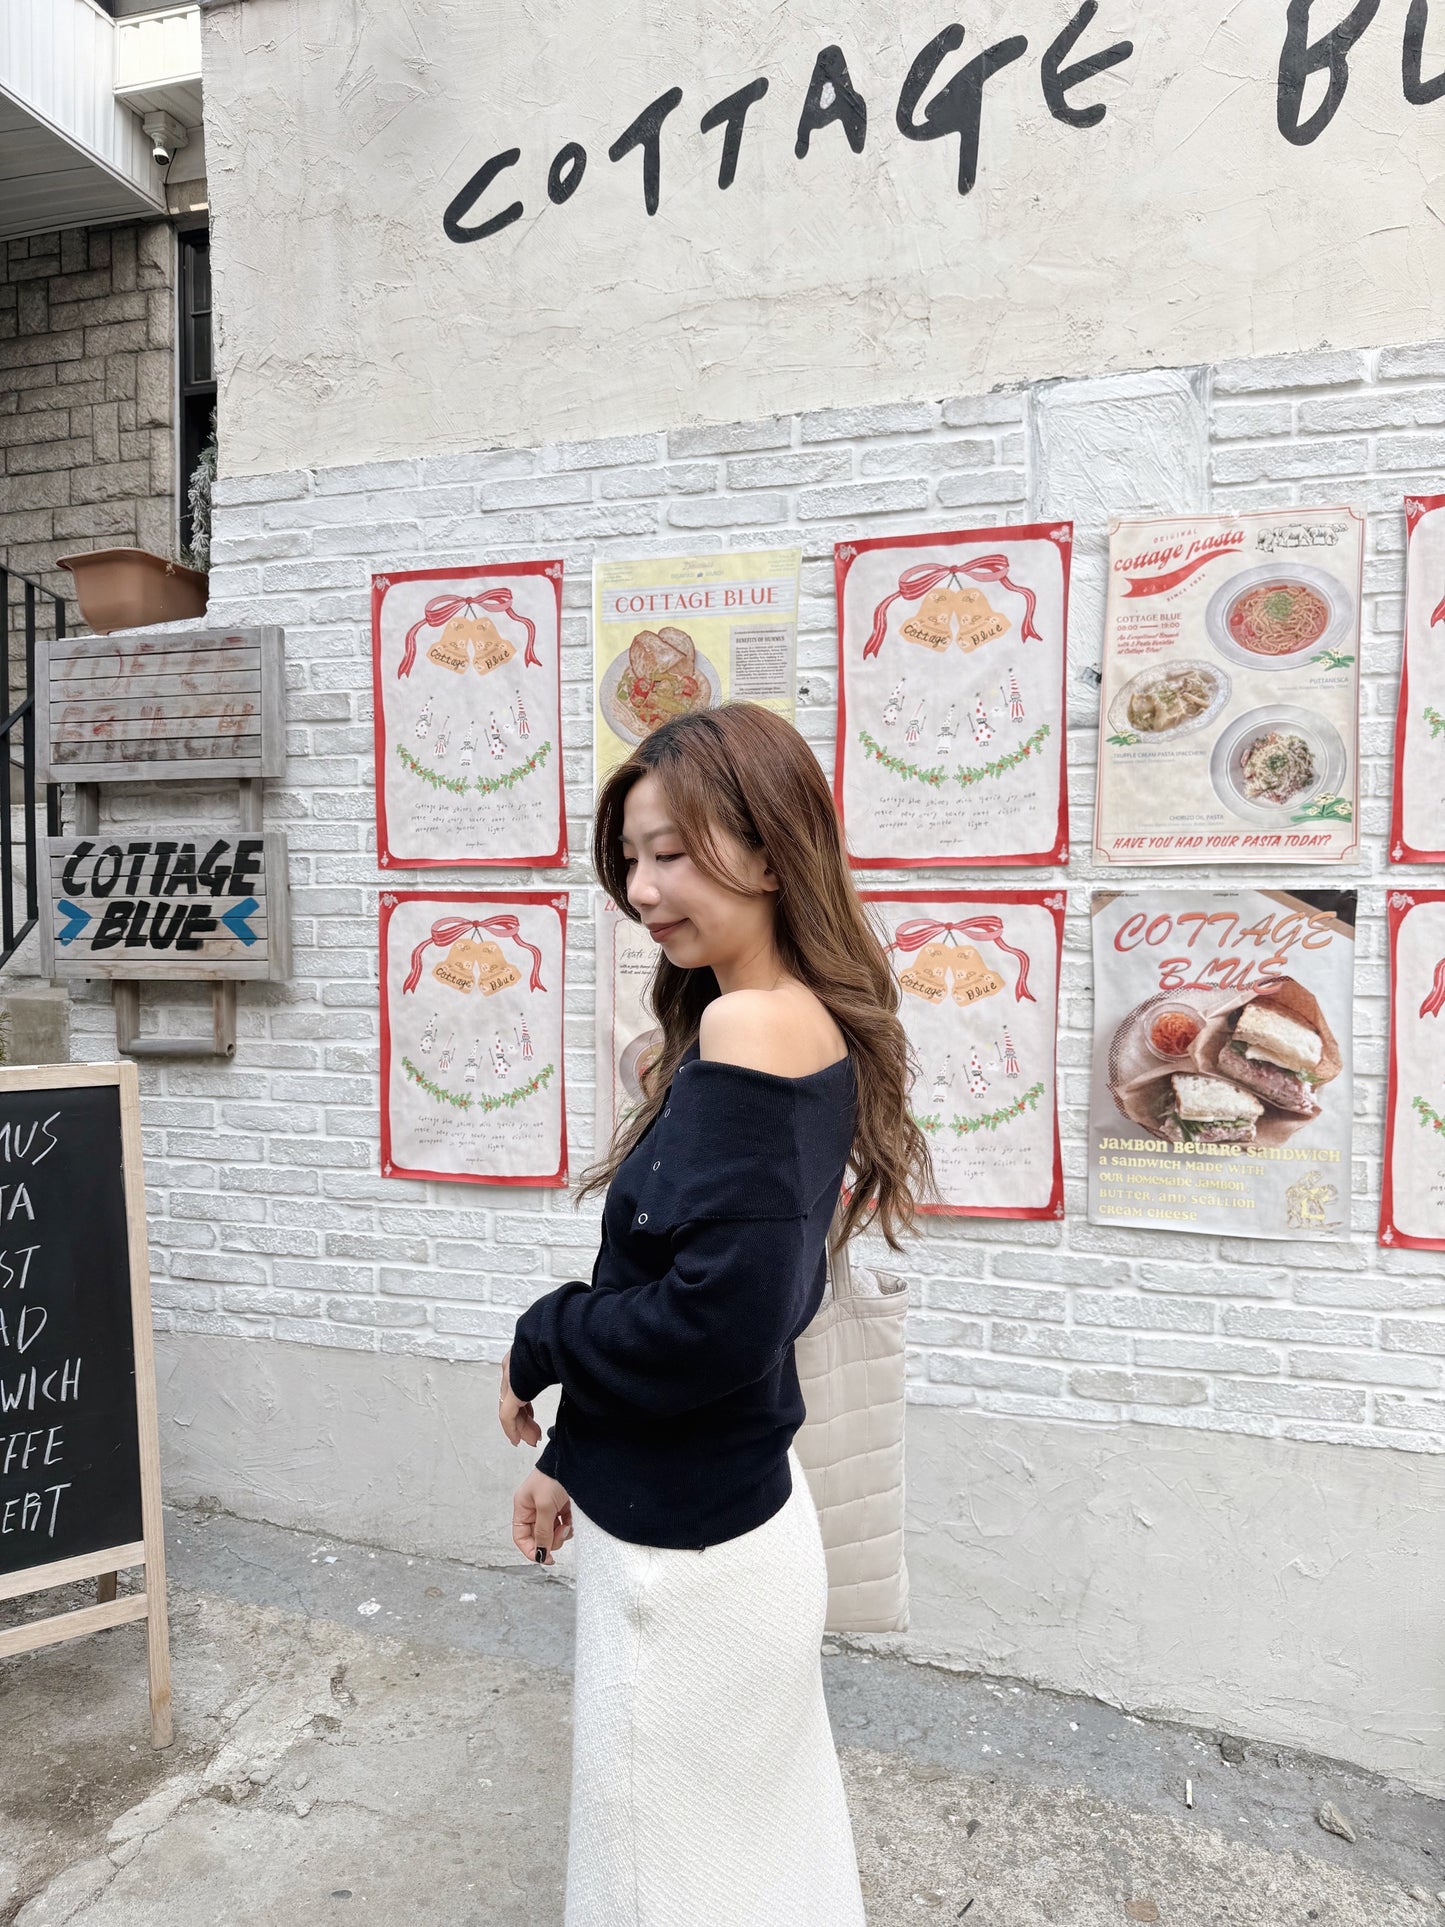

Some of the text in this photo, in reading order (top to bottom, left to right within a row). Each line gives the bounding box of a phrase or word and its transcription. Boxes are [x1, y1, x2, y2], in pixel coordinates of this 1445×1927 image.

[443, 0, 1133, 243] COTTAGE
[1114, 531, 1245, 571] cottage pasta
[615, 586, 780, 613] COTTAGE BLUE
[1116, 613, 1182, 623] COTTAGE BLUE
[904, 625, 948, 649] Cottage
[430, 648, 466, 669] Cottage
[1112, 834, 1332, 849] HAVE YOU HAD YOUR PASTA TODAY?
[62, 839, 264, 898] COTTAGE
[91, 900, 220, 951] BLUE
[1114, 911, 1338, 959] COTTAGE
[436, 968, 473, 990] Cottage
[900, 974, 942, 998] Cottage
[1158, 956, 1288, 994] BLUE
